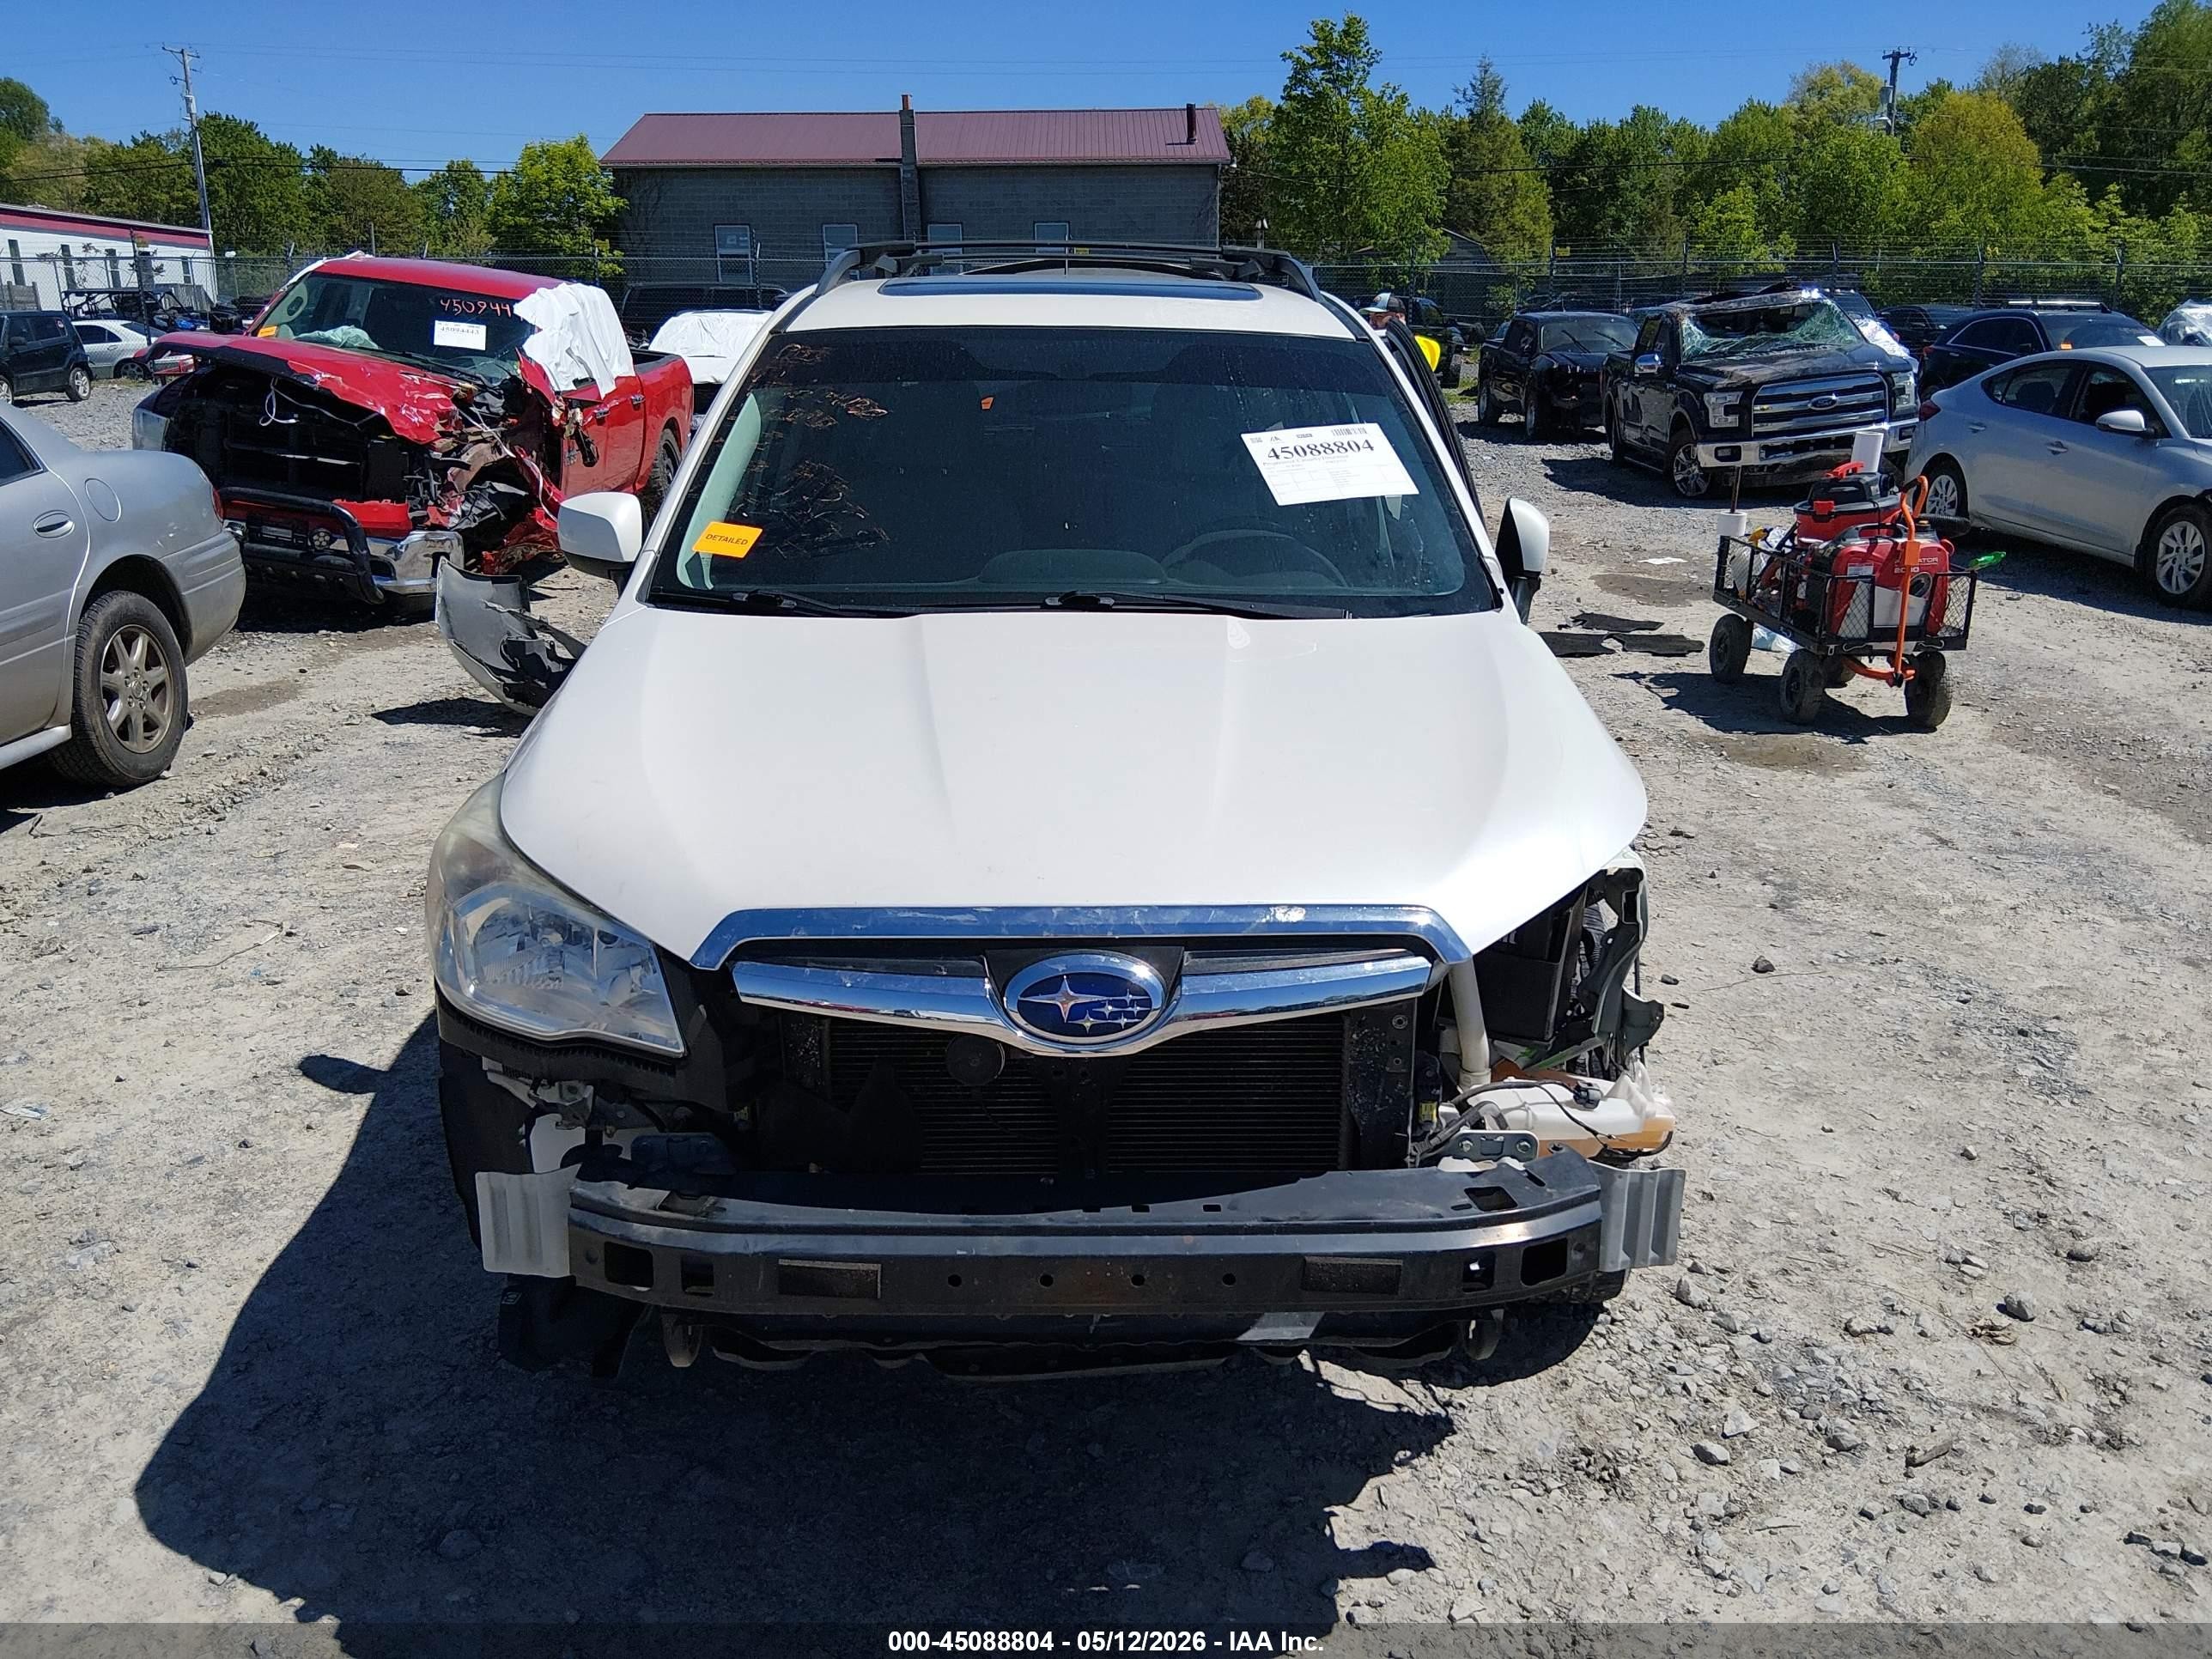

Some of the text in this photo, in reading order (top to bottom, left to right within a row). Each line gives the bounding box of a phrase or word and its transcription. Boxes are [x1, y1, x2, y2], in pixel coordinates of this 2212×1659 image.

[440, 299, 523, 321] 450944
[1267, 439, 1374, 460] 45088804
[706, 534, 748, 544] DETAILED
